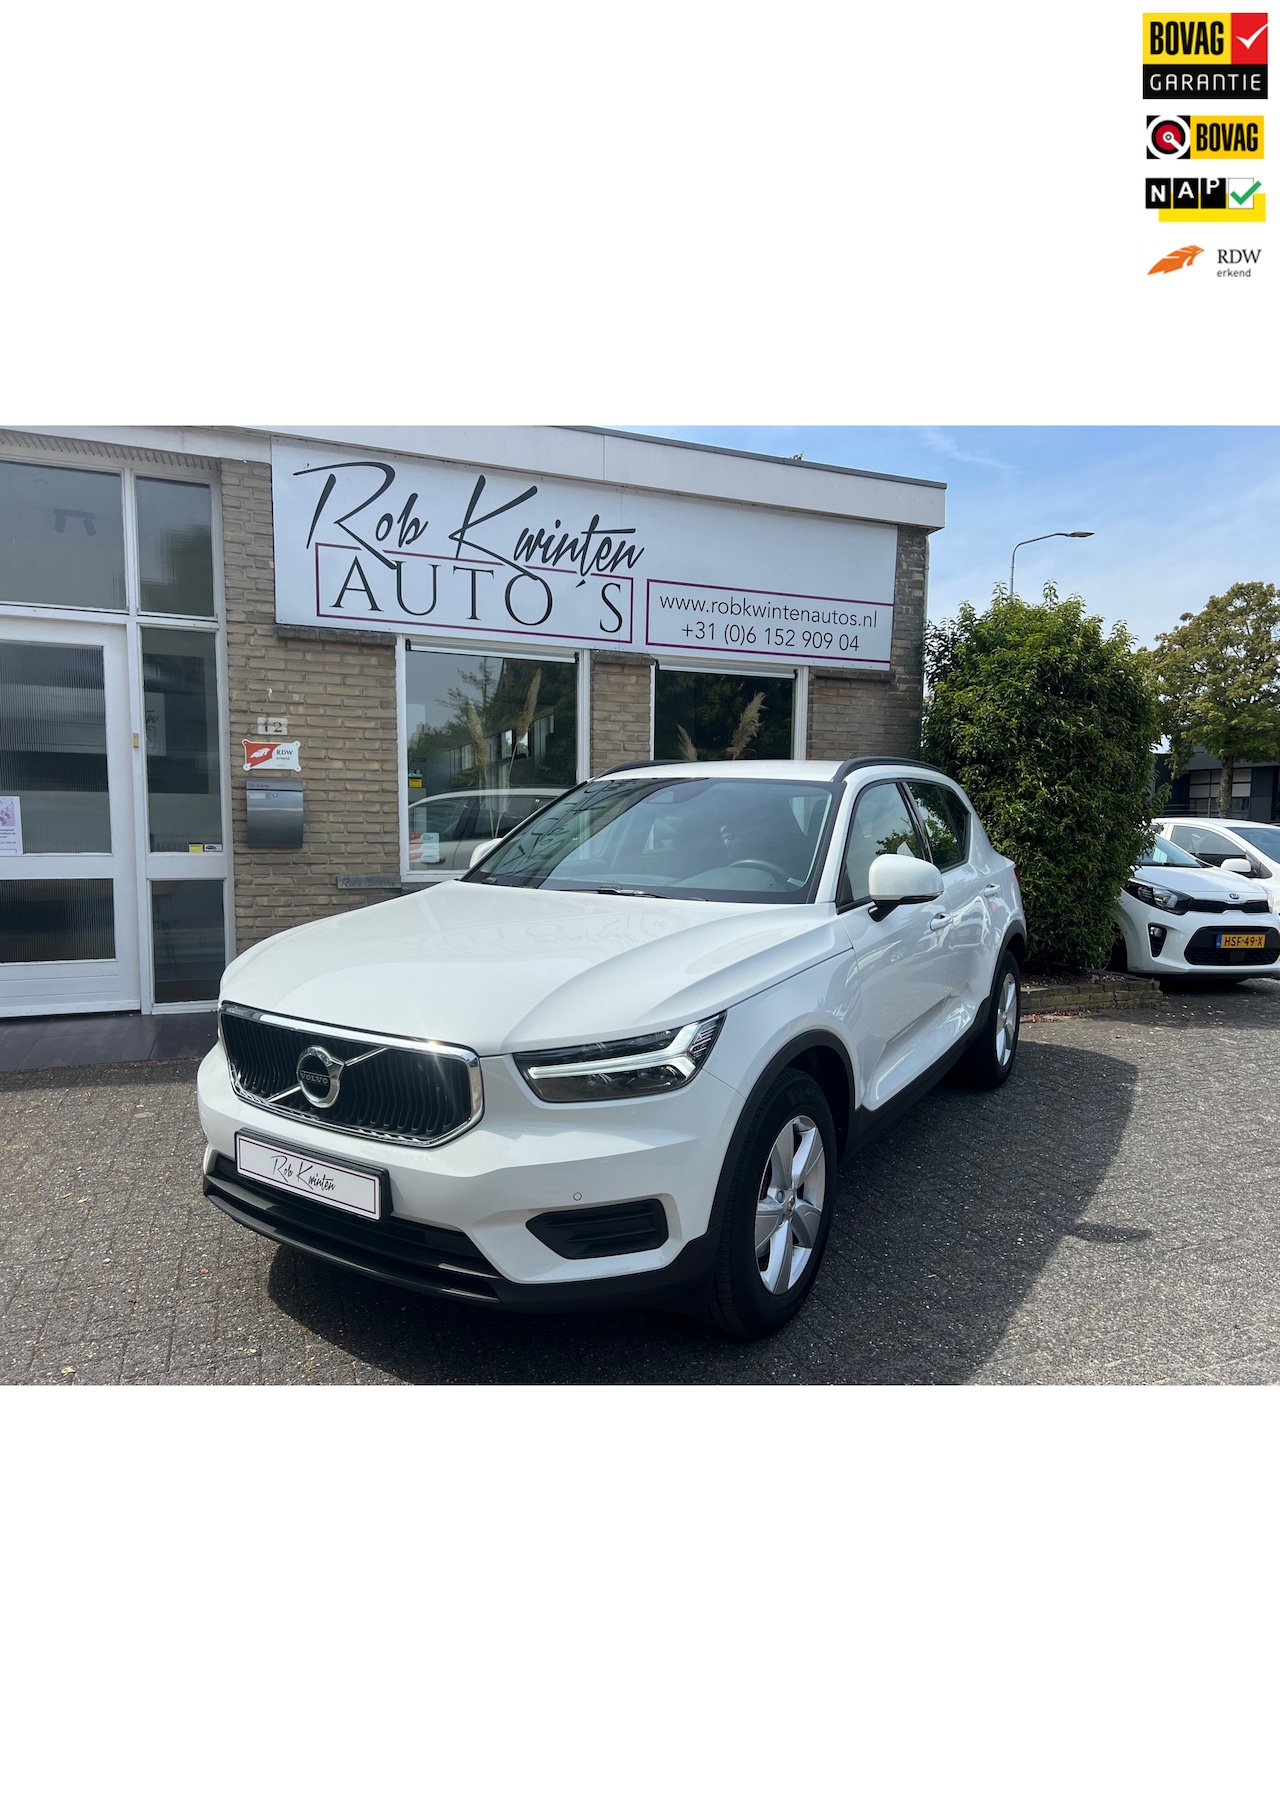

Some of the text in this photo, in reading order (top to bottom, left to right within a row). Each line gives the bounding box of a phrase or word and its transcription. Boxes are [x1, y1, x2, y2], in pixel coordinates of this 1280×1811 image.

[293, 461, 429, 570] Rob
[659, 595, 878, 628] www.robkwintenautos.nl
[682, 621, 860, 652] +31 (0)6 152 909 04
[262, 721, 283, 733] 12
[1224, 936, 1263, 947] HSF-49-X
[299, 1072, 328, 1085] VOLVO
[271, 1155, 294, 1183] Rob
